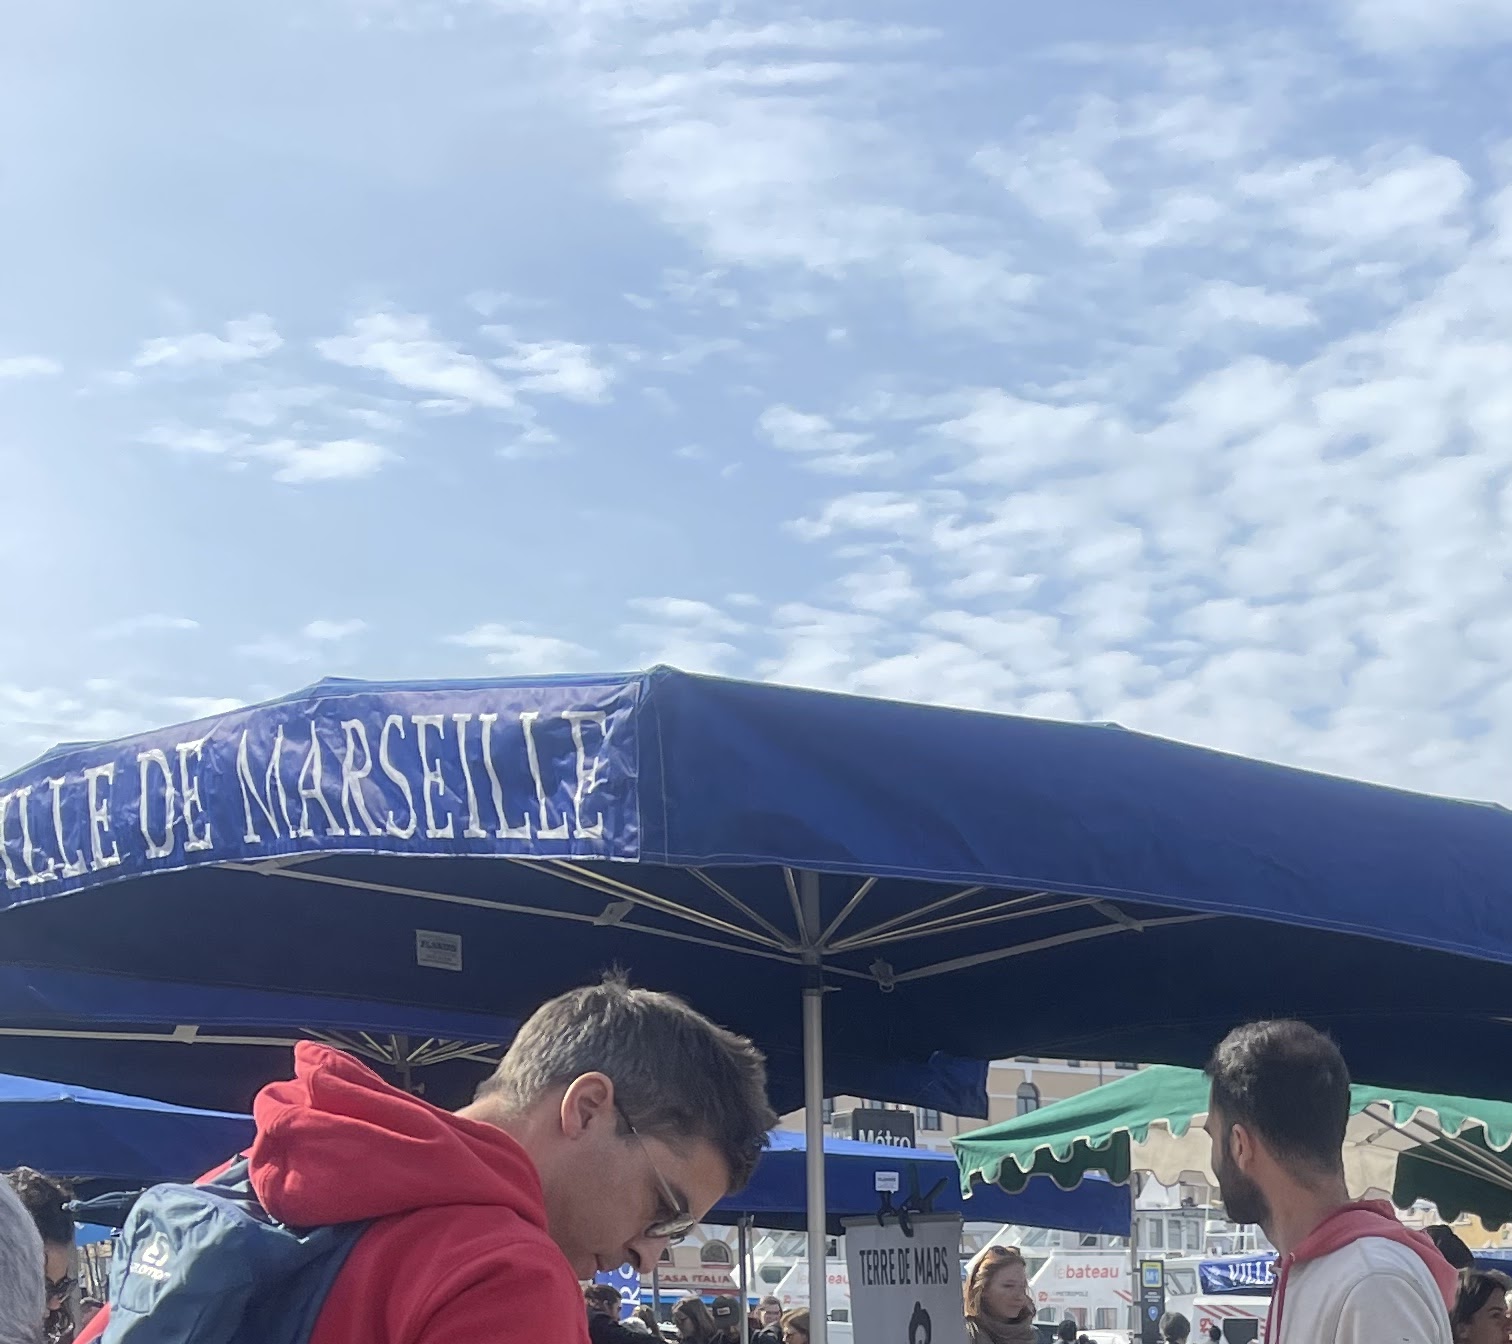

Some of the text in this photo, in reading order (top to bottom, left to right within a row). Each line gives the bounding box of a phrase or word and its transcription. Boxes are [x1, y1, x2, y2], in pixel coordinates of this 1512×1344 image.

[0, 709, 609, 889] ILLE DE MARSEILLE
[858, 1129, 912, 1148] Métro
[859, 1246, 949, 1286] TERRE DE MARS
[1228, 1260, 1276, 1285] VILLE
[657, 1274, 731, 1284] CASA ITALIA
